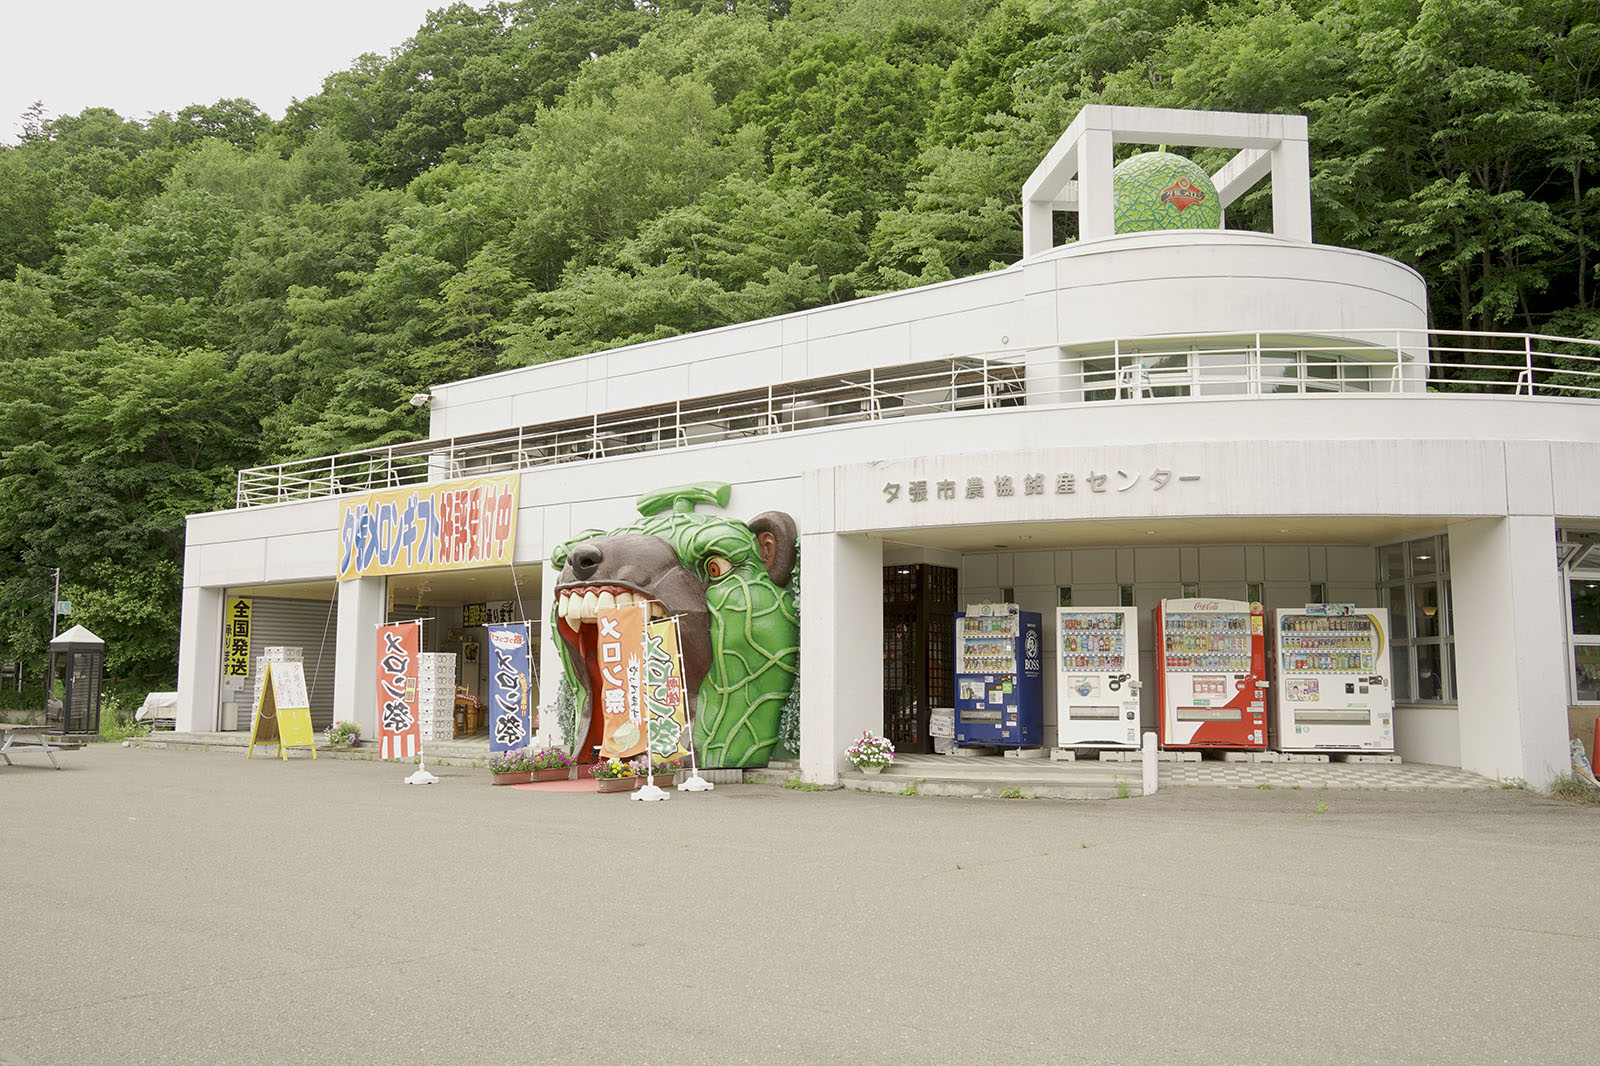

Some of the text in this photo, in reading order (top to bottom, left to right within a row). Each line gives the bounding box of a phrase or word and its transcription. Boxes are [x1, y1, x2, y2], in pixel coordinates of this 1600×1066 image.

[882, 467, 1201, 504] 夕張市農協銘産センター
[340, 481, 513, 575] 夕張メロンギフト好評受付中
[224, 624, 232, 675] 承ります
[230, 600, 250, 676] 全国発送
[1024, 659, 1040, 671] BOSS
